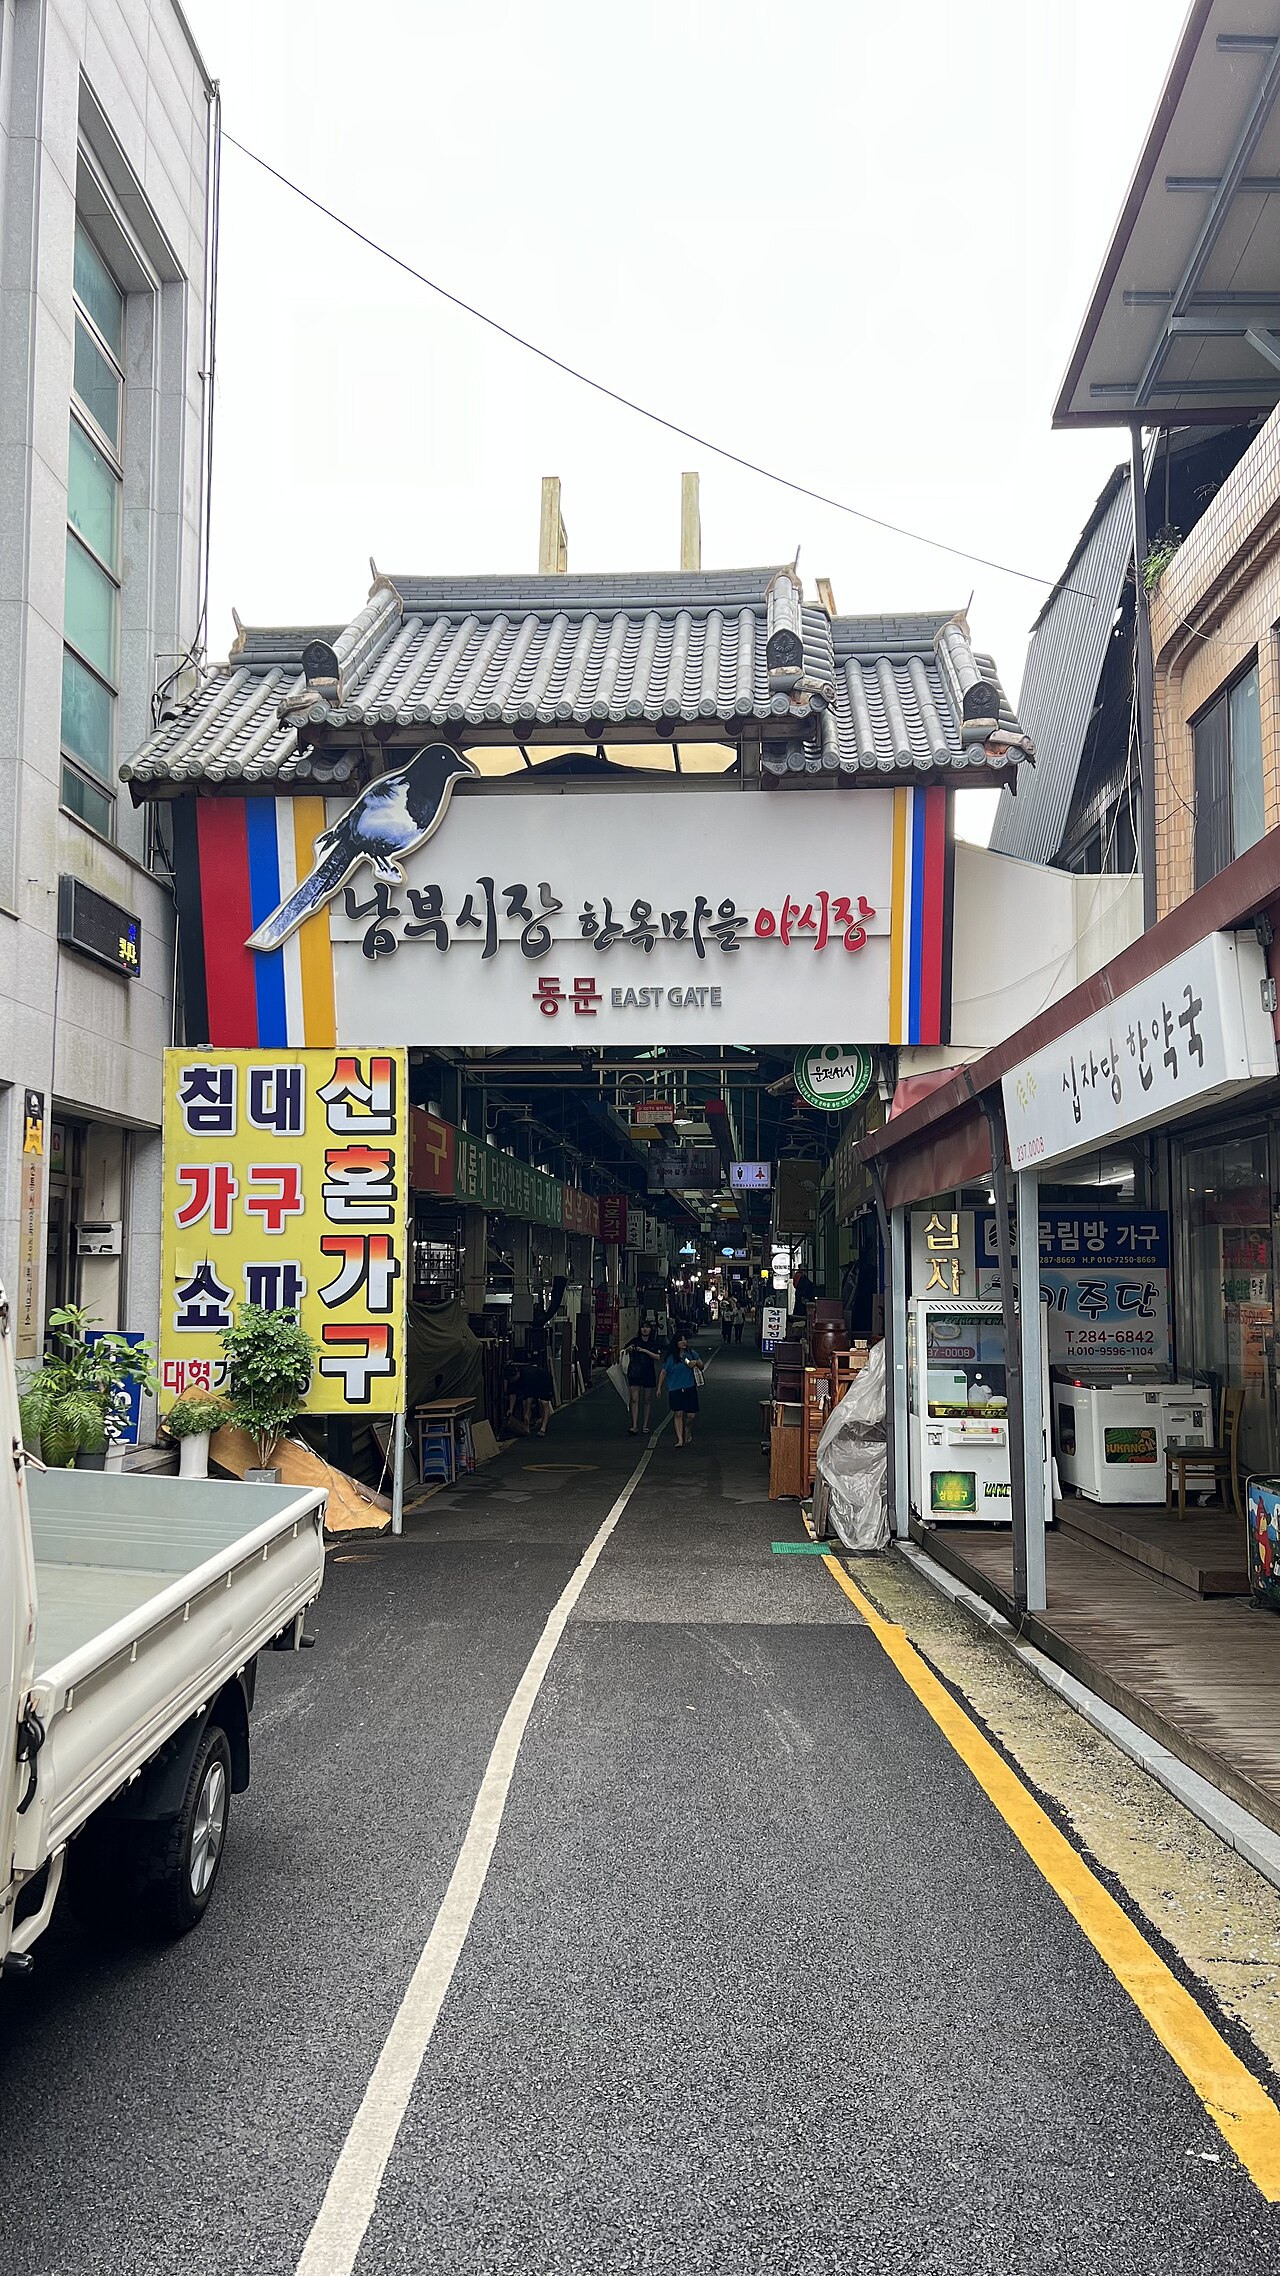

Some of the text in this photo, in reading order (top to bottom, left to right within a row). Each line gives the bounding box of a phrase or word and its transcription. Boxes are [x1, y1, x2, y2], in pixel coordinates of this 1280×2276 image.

[342, 877, 877, 961] 남부시장 한옥마을 야시장
[532, 976, 723, 1018] 동문 EAST GATE
[1062, 983, 1205, 1124] 십자당 한약국
[177, 1063, 305, 1136] 침대
[174, 1162, 305, 1235] 가구
[564, 1185, 600, 1230] 신혼가구
[604, 1197, 621, 1239] 신혼가구
[316, 1057, 401, 1404] 신혼가구
[1039, 1256, 1076, 1264] 287-8669
[1096, 1256, 1157, 1264] 010-7250-8669
[1116, 1225, 1160, 1251] 가구
